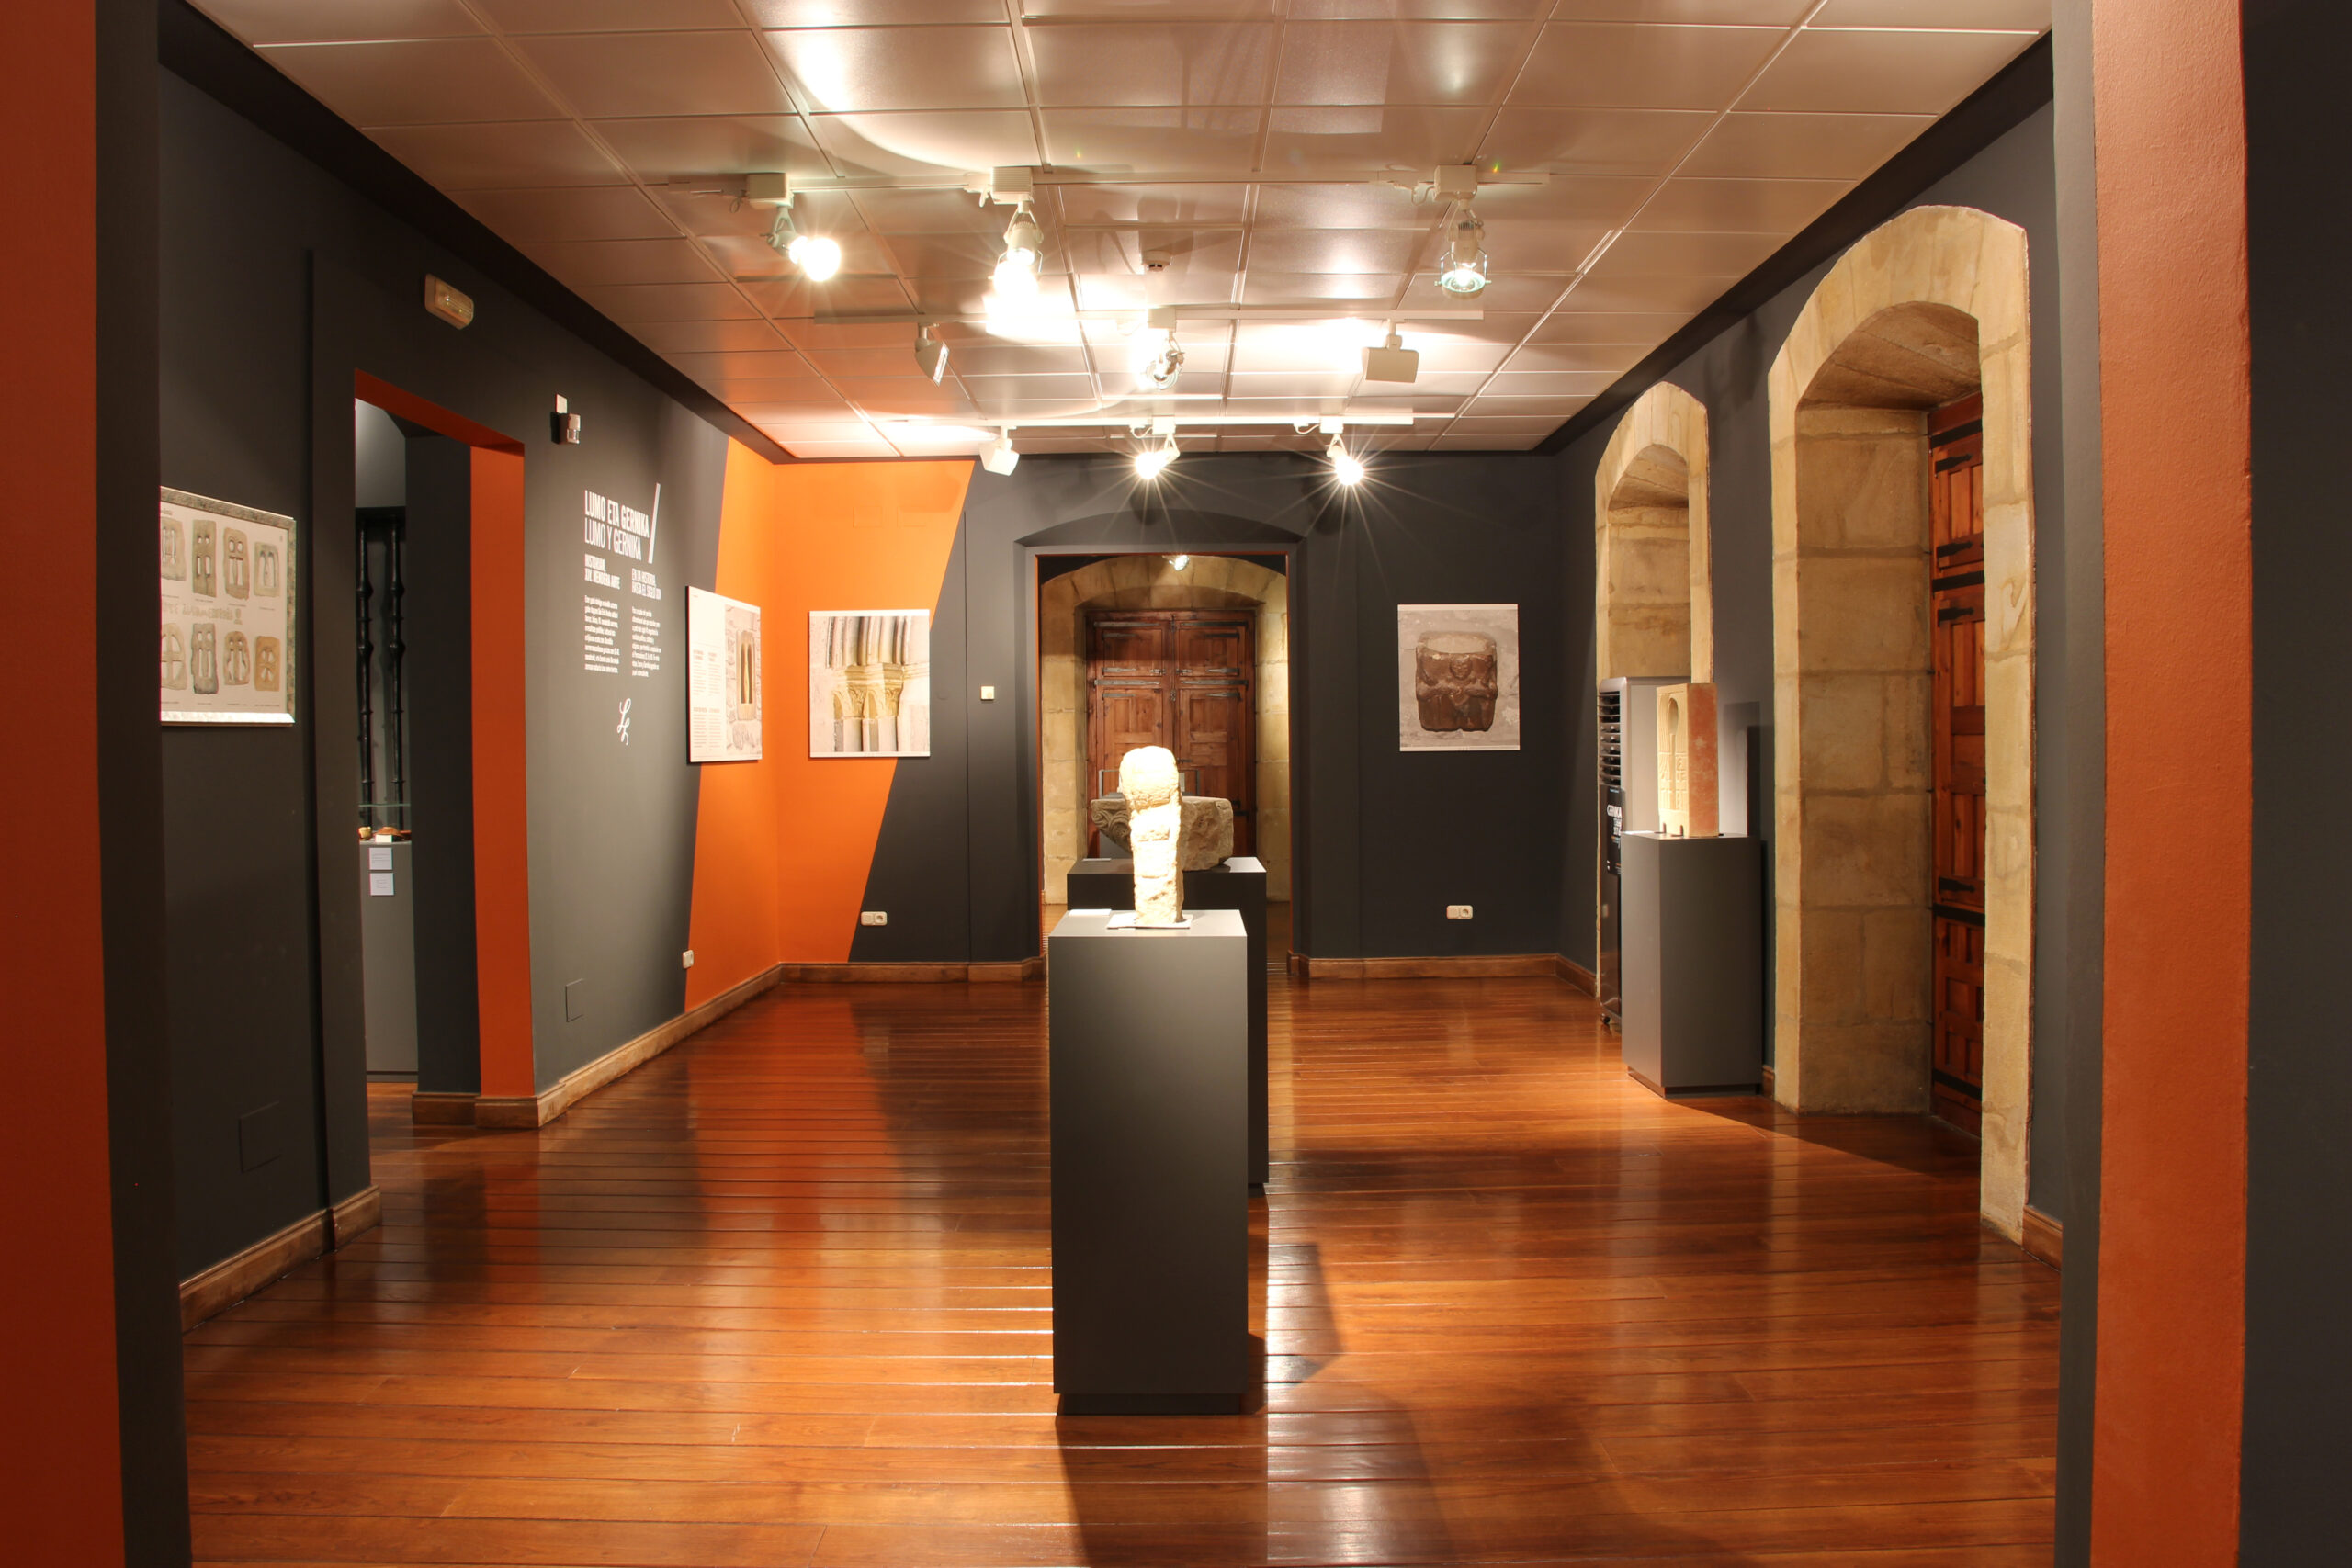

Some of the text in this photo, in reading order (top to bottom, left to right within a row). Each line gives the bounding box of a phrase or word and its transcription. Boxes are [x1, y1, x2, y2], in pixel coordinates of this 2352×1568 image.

[584, 490, 650, 539] LUMO ETA GERNIKA
[584, 517, 642, 561] LUMO Y GERNIKA
